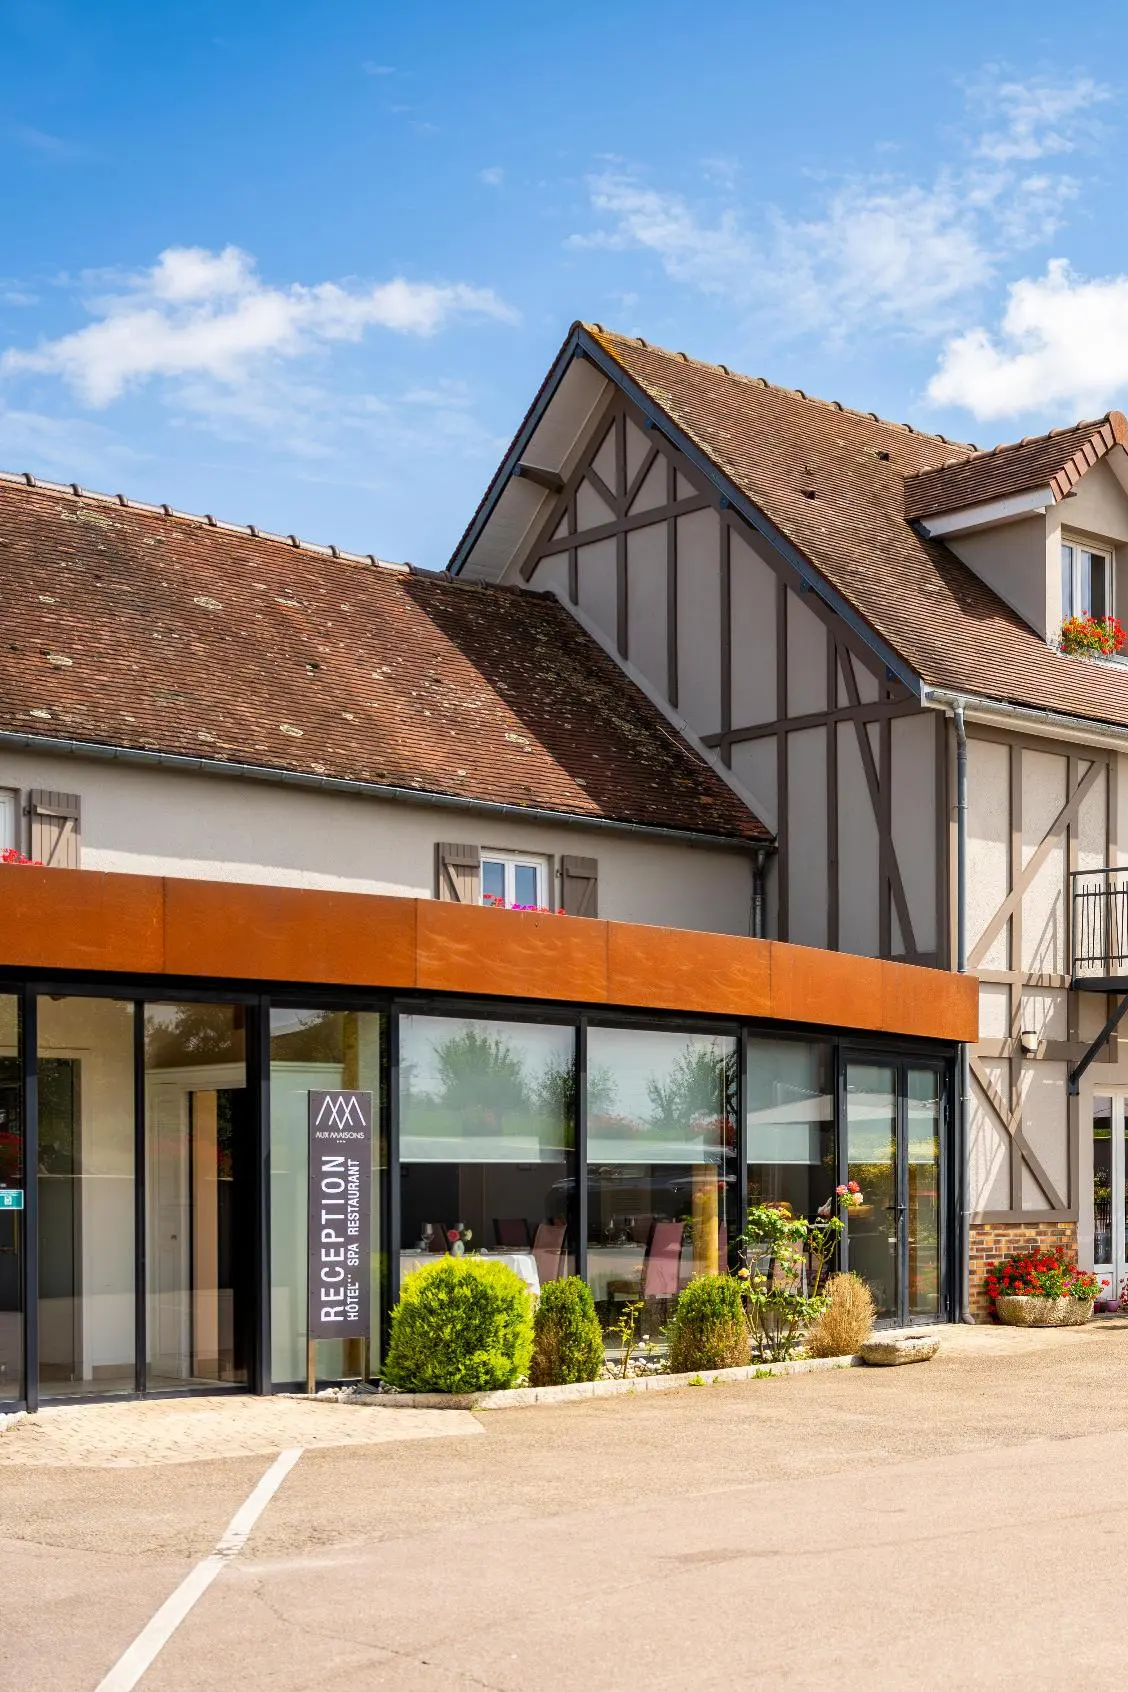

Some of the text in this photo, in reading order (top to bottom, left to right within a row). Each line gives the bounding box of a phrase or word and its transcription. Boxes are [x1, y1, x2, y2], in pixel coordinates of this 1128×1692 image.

[315, 1131, 365, 1139] AUX MAISONS
[347, 1158, 360, 1236] RESTAURANT
[320, 1156, 345, 1322] RECEPTION
[347, 1243, 359, 1266] SPA
